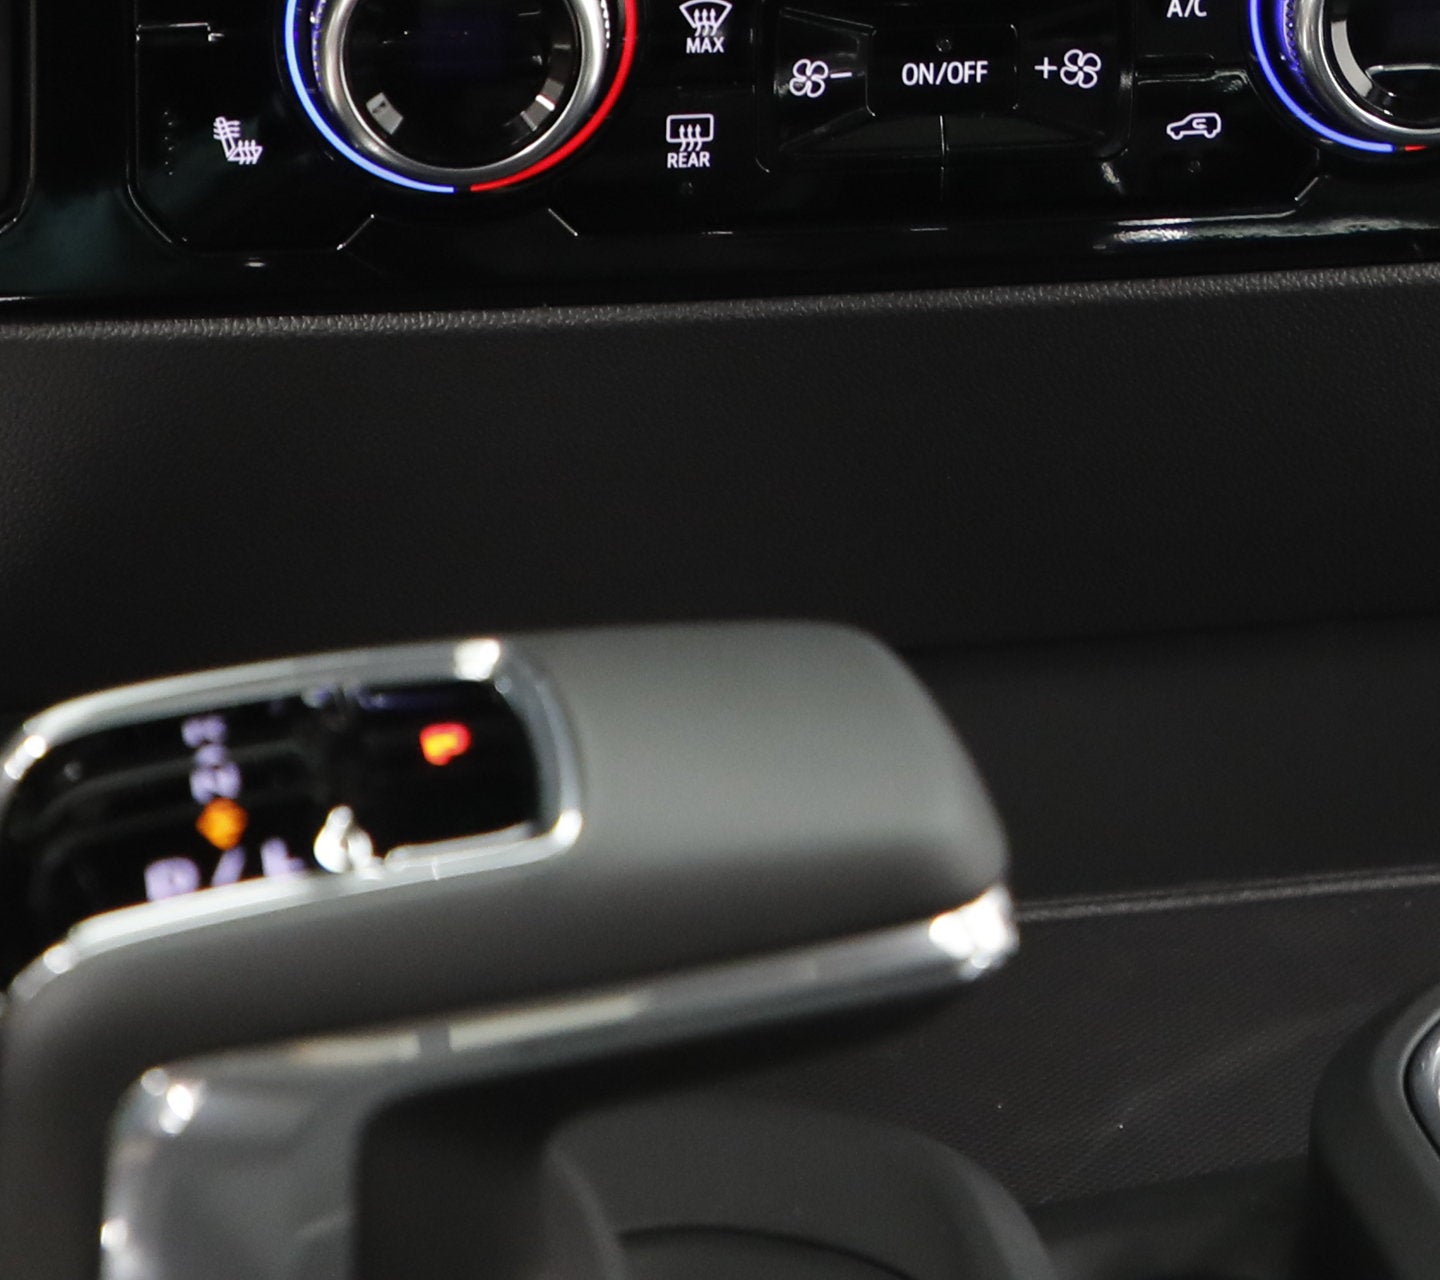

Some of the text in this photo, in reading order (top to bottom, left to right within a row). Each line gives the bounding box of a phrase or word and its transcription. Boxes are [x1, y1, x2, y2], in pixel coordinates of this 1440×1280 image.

[687, 34, 724, 53] MAX
[902, 61, 988, 85] ON/OFF
[668, 148, 710, 168] REAR
